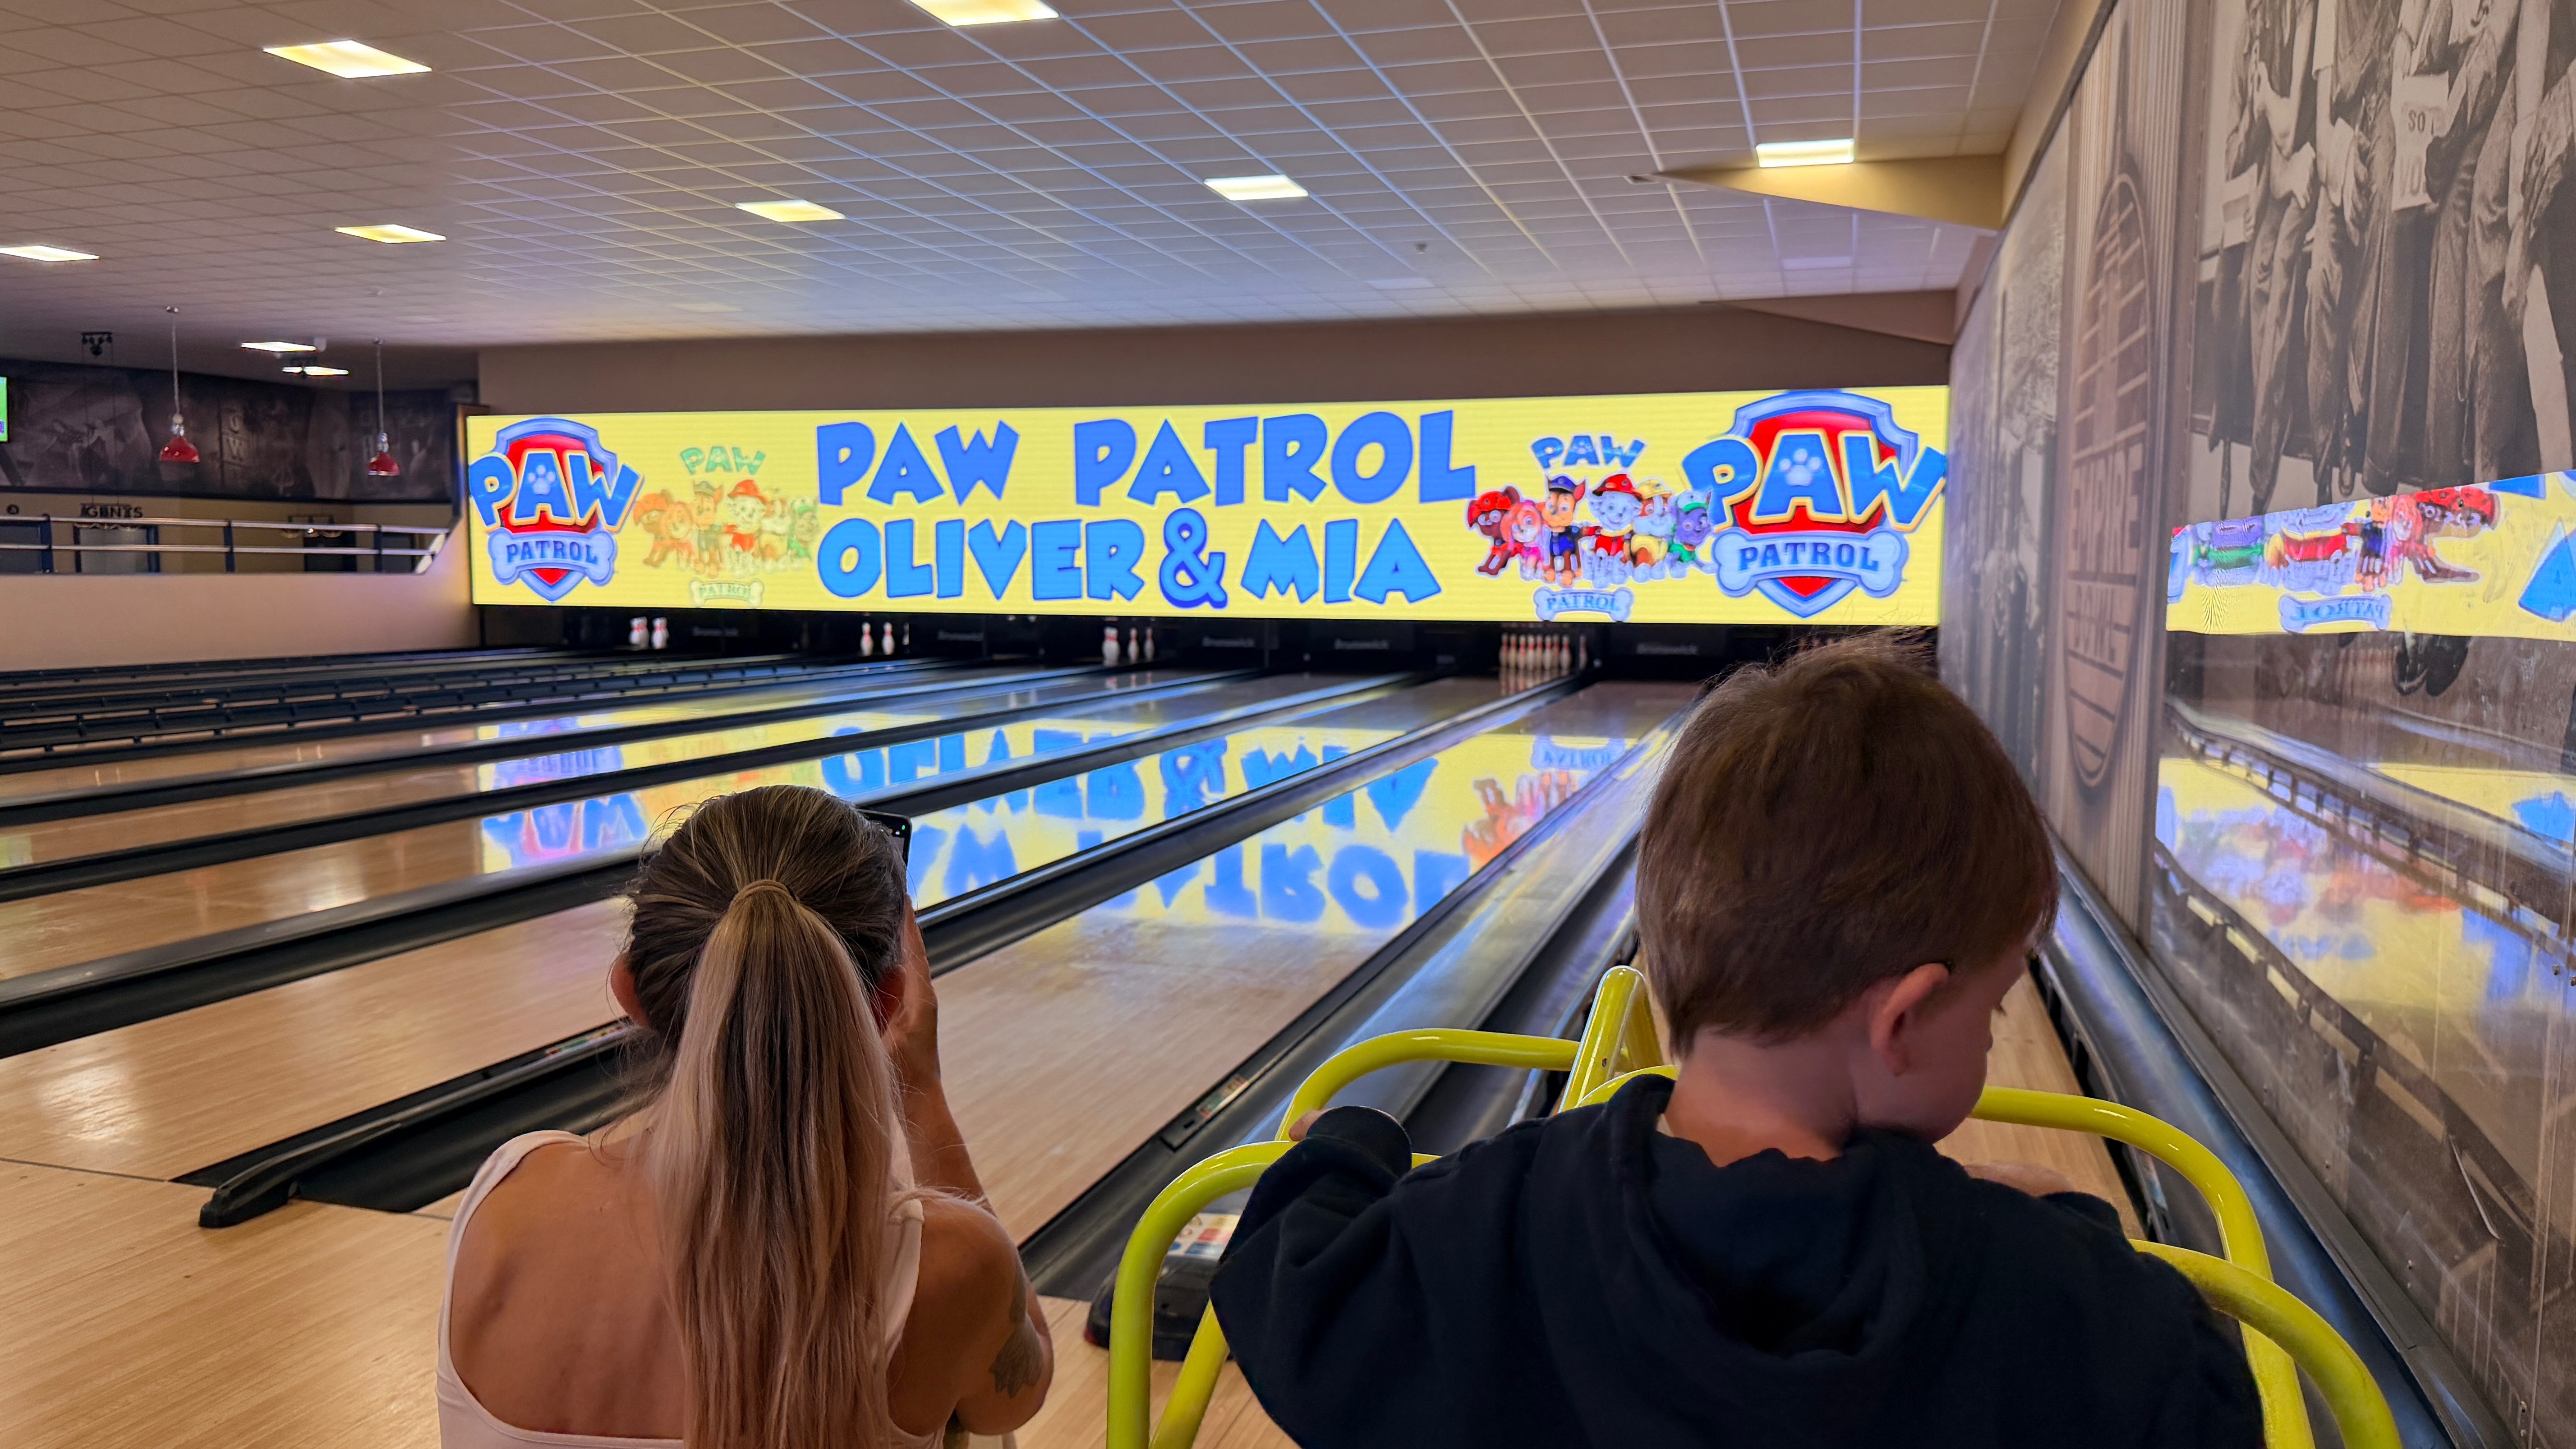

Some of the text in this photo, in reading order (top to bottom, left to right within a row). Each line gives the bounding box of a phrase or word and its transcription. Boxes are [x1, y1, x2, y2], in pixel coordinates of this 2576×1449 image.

[680, 446, 766, 475] PAW
[817, 410, 1476, 507] PAW PATROL
[1531, 435, 1646, 469] PAW
[468, 448, 644, 533] PAW
[1680, 429, 1946, 532] PAW
[87, 505, 143, 519] GNTS
[2069, 443, 2143, 574] EMPIRE
[506, 541, 599, 564] PATROL
[817, 508, 1441, 609] OLIVER & MIA
[1739, 543, 1879, 571] PATROL
[1546, 594, 1620, 612] PATROL
